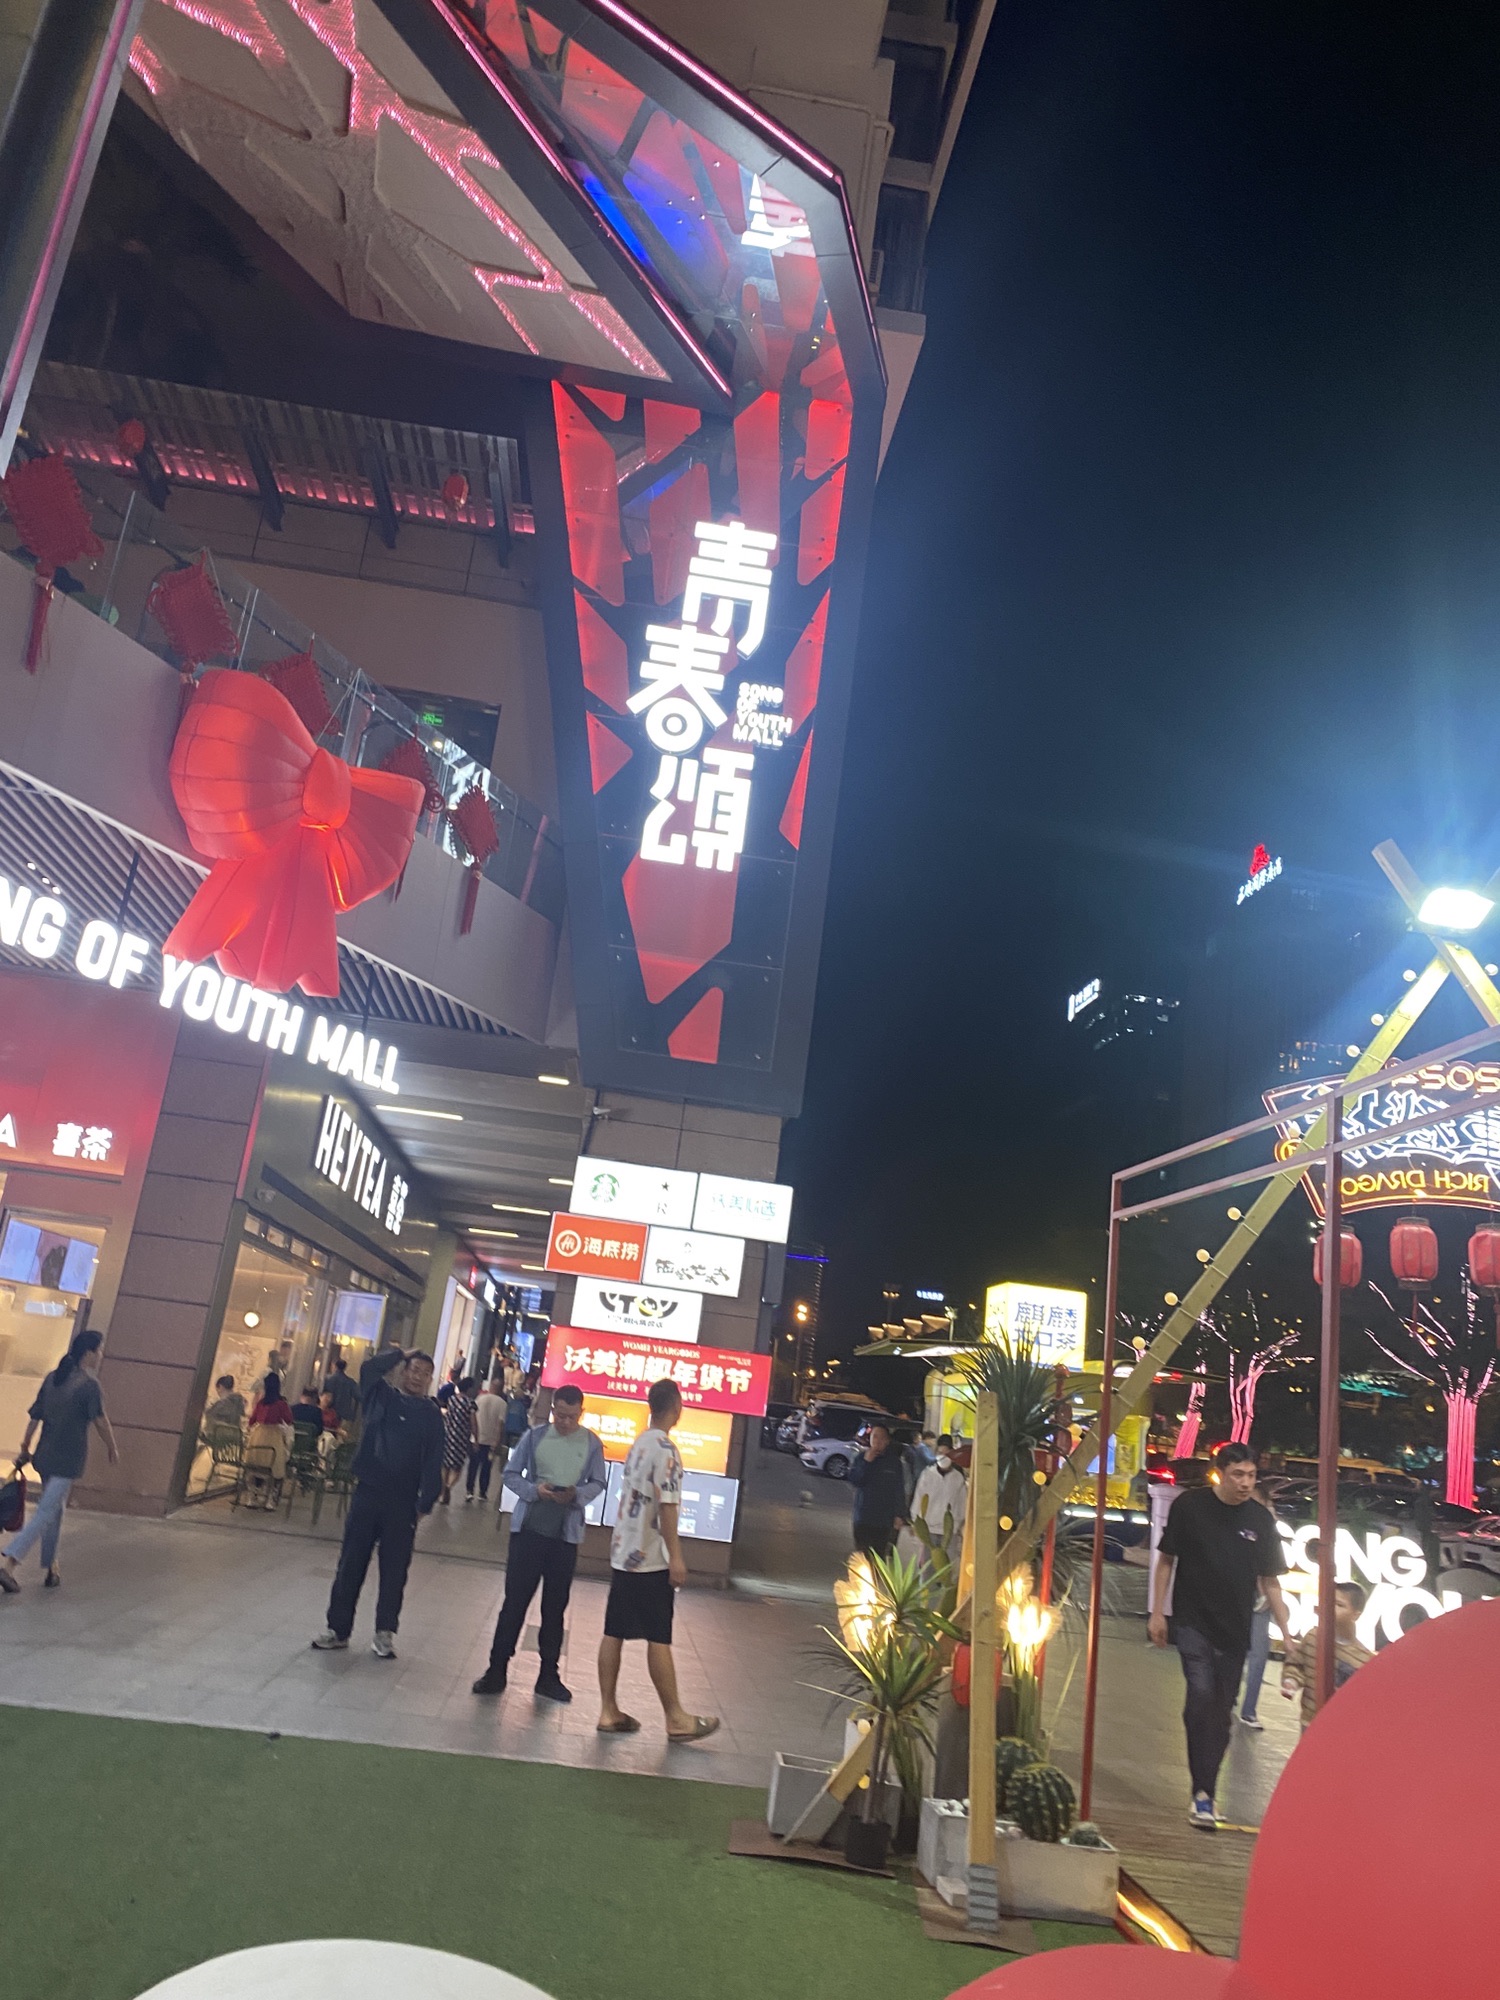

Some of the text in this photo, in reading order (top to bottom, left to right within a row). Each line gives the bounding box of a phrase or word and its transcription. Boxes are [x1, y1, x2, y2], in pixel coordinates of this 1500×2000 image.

[737, 697, 759, 712] OF
[739, 682, 784, 704] SONG
[737, 709, 793, 734] YOUTH
[732, 723, 783, 747] MALL
[75, 919, 149, 989] OF
[159, 954, 304, 1055] YOUTH
[307, 1015, 400, 1095] MALL
[52, 1122, 113, 1161] 喜茶
[314, 1094, 388, 1219] HEYTEA
[582, 1236, 640, 1262] 海底捞
